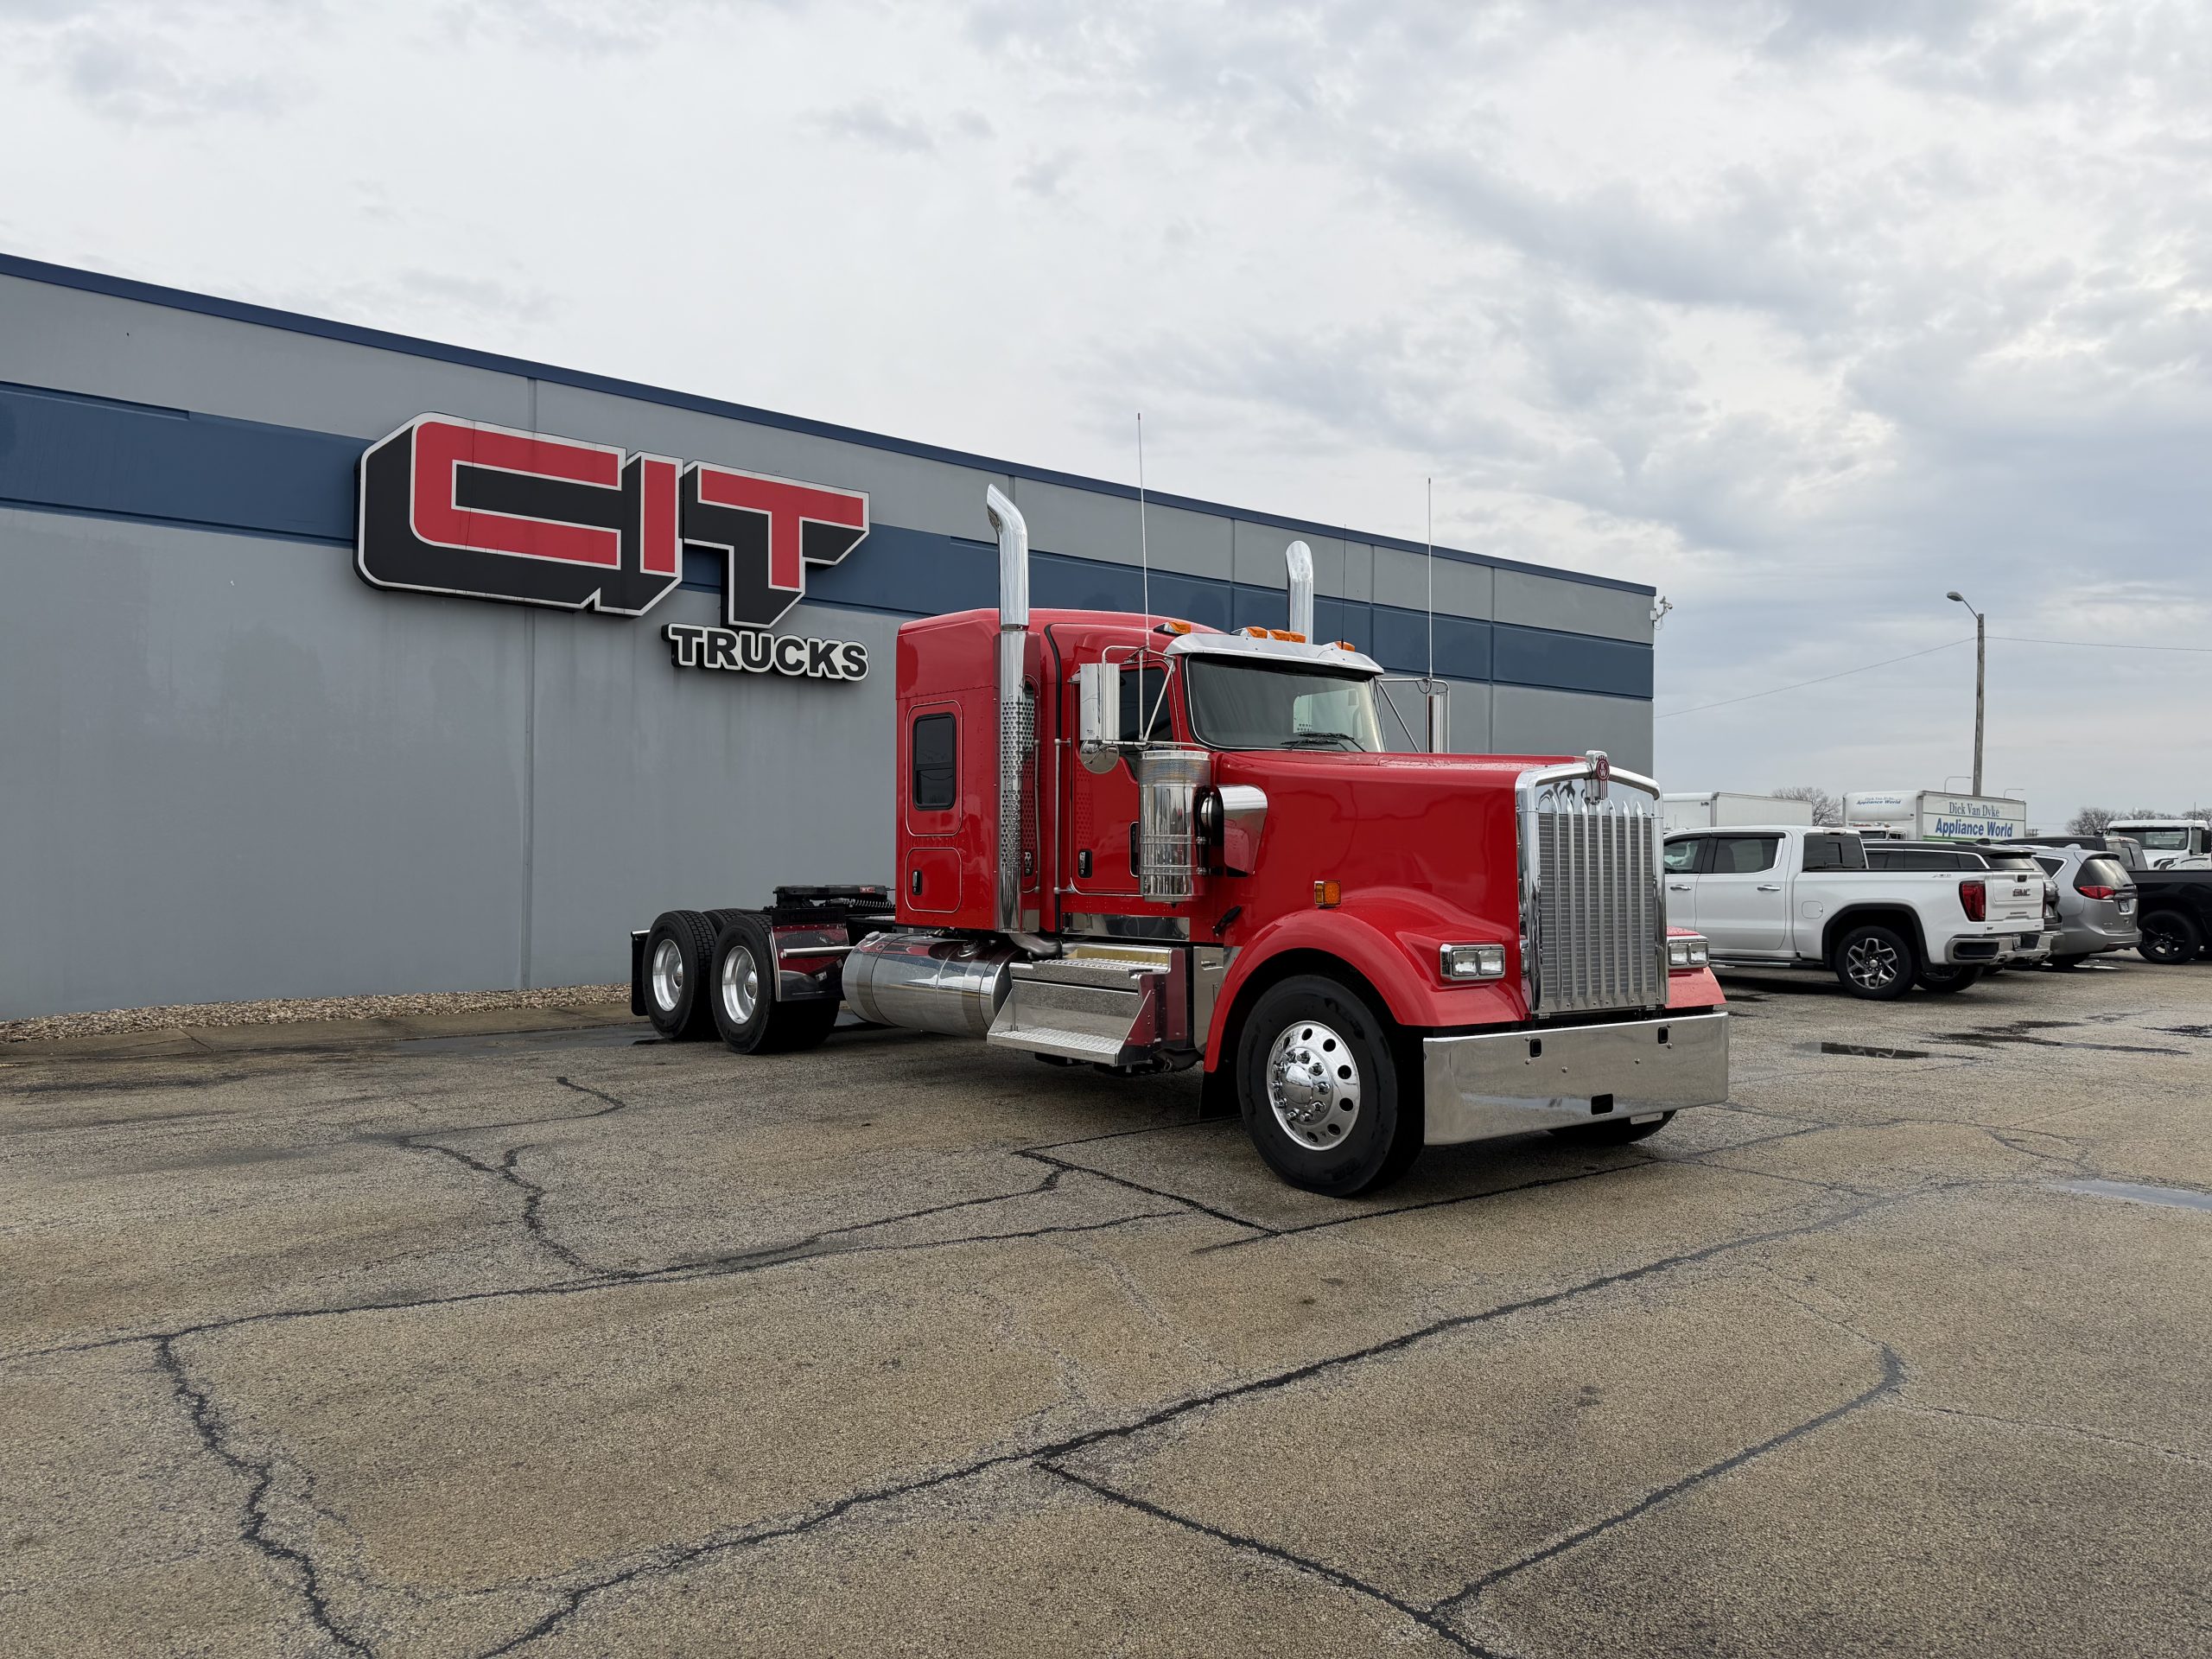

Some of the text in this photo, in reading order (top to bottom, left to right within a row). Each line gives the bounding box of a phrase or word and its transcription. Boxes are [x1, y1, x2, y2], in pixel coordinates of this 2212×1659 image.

[357, 412, 869, 628] CIT
[668, 623, 869, 681] TRUCKS
[1948, 801, 2000, 819] Dick Van Dyke
[1935, 817, 2013, 838] Appliance World
[2012, 888, 2031, 897] GMC
